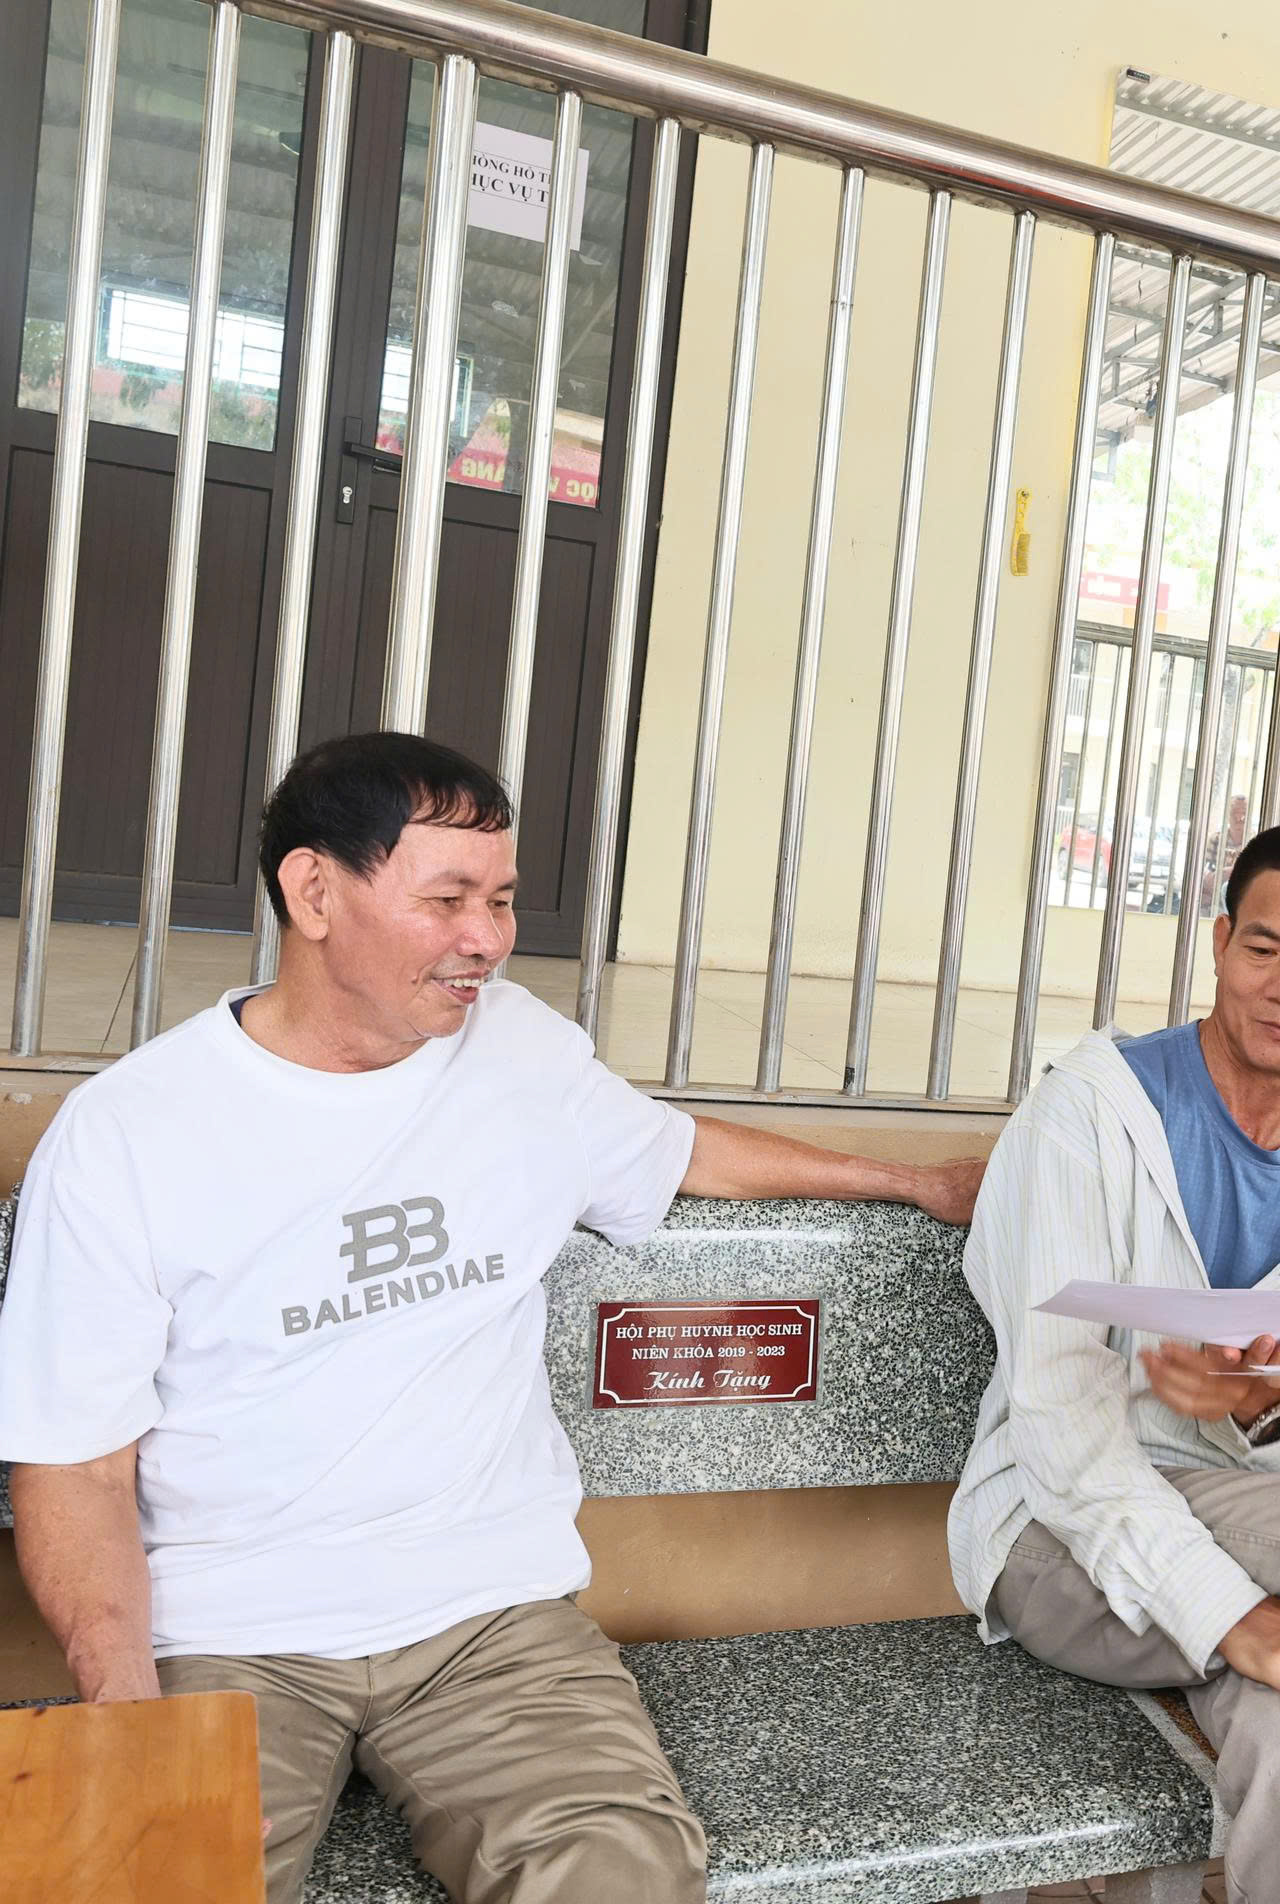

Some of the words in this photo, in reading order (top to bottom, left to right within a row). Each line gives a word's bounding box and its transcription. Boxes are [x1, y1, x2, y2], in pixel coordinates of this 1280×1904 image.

[509, 182, 532, 202] VỤ
[281, 1253, 505, 1337] BALENDIAE
[616, 1323, 643, 1342] HỘI
[648, 1326, 676, 1340] PHỤ
[681, 1325, 733, 1337] HUYNH
[736, 1324, 766, 1339] HỌC
[768, 1323, 802, 1336] SINH
[632, 1345, 668, 1360] NIÊN
[673, 1343, 714, 1358] KHÓA
[718, 1346, 745, 1357] 2019
[757, 1345, 785, 1356] 2023
[644, 1370, 705, 1390] Kính
[713, 1369, 772, 1391] Tặng
